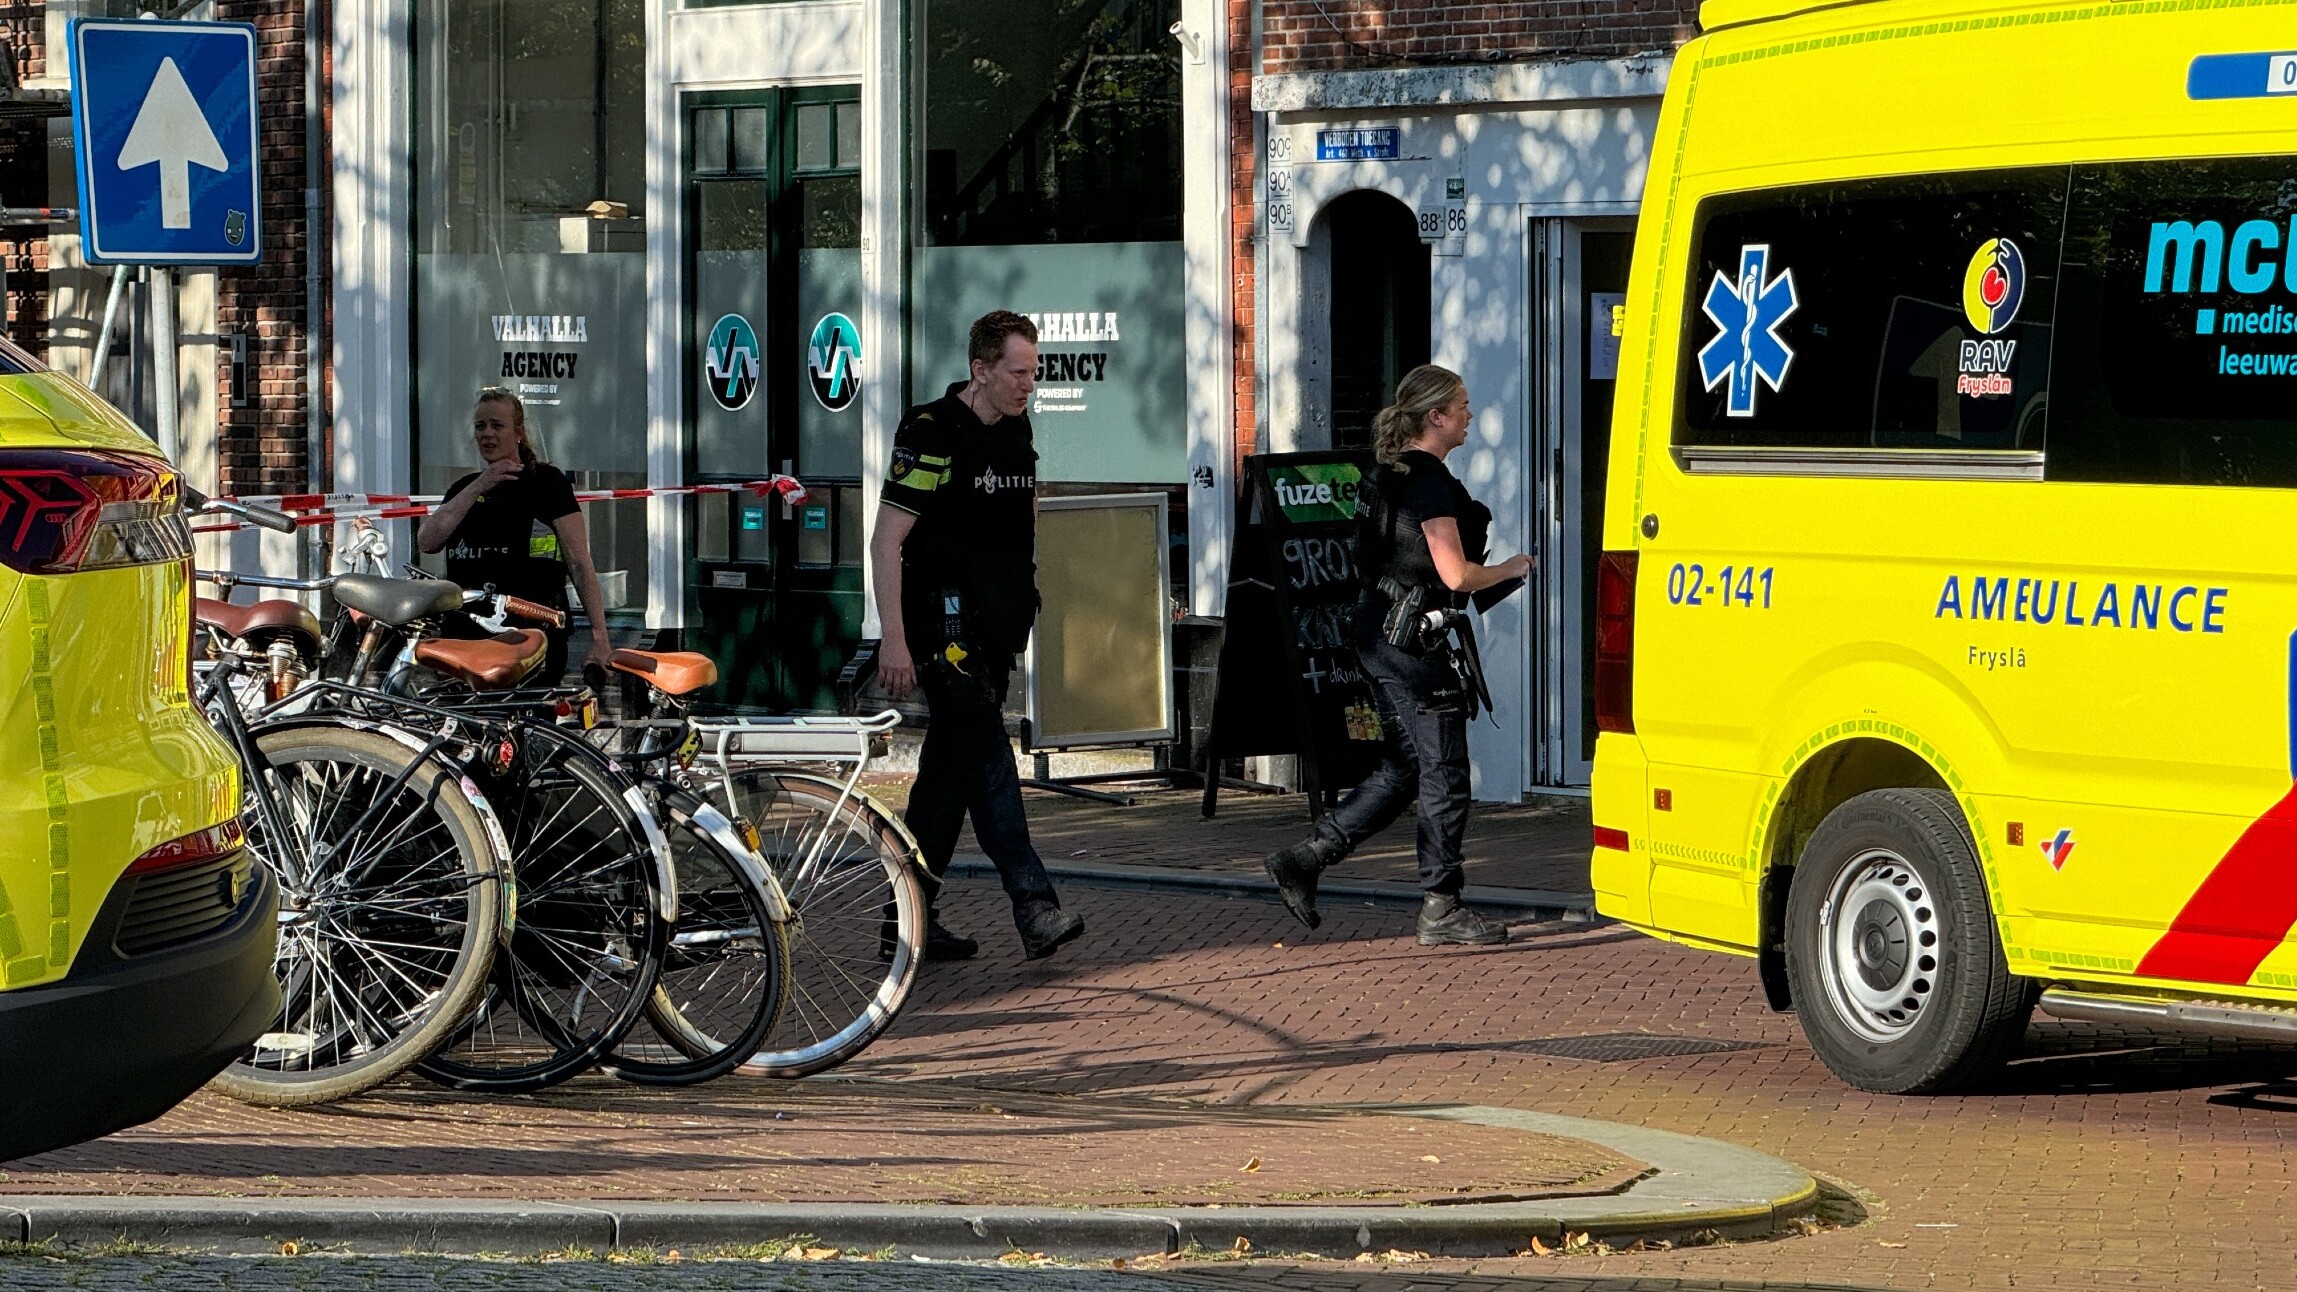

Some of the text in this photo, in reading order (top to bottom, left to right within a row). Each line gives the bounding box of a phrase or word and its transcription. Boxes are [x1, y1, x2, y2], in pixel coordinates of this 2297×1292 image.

[1448, 208, 1466, 232] 86
[491, 315, 588, 343] VALHALLA
[1028, 312, 1120, 342] LHALLA
[501, 351, 578, 379] AGENCY
[1034, 353, 1107, 382] GENCY
[1959, 339, 2016, 372] RAV
[1036, 388, 1084, 399] POWERED BY
[1957, 373, 2013, 398] Fryslân
[1667, 562, 1774, 609] 02-141
